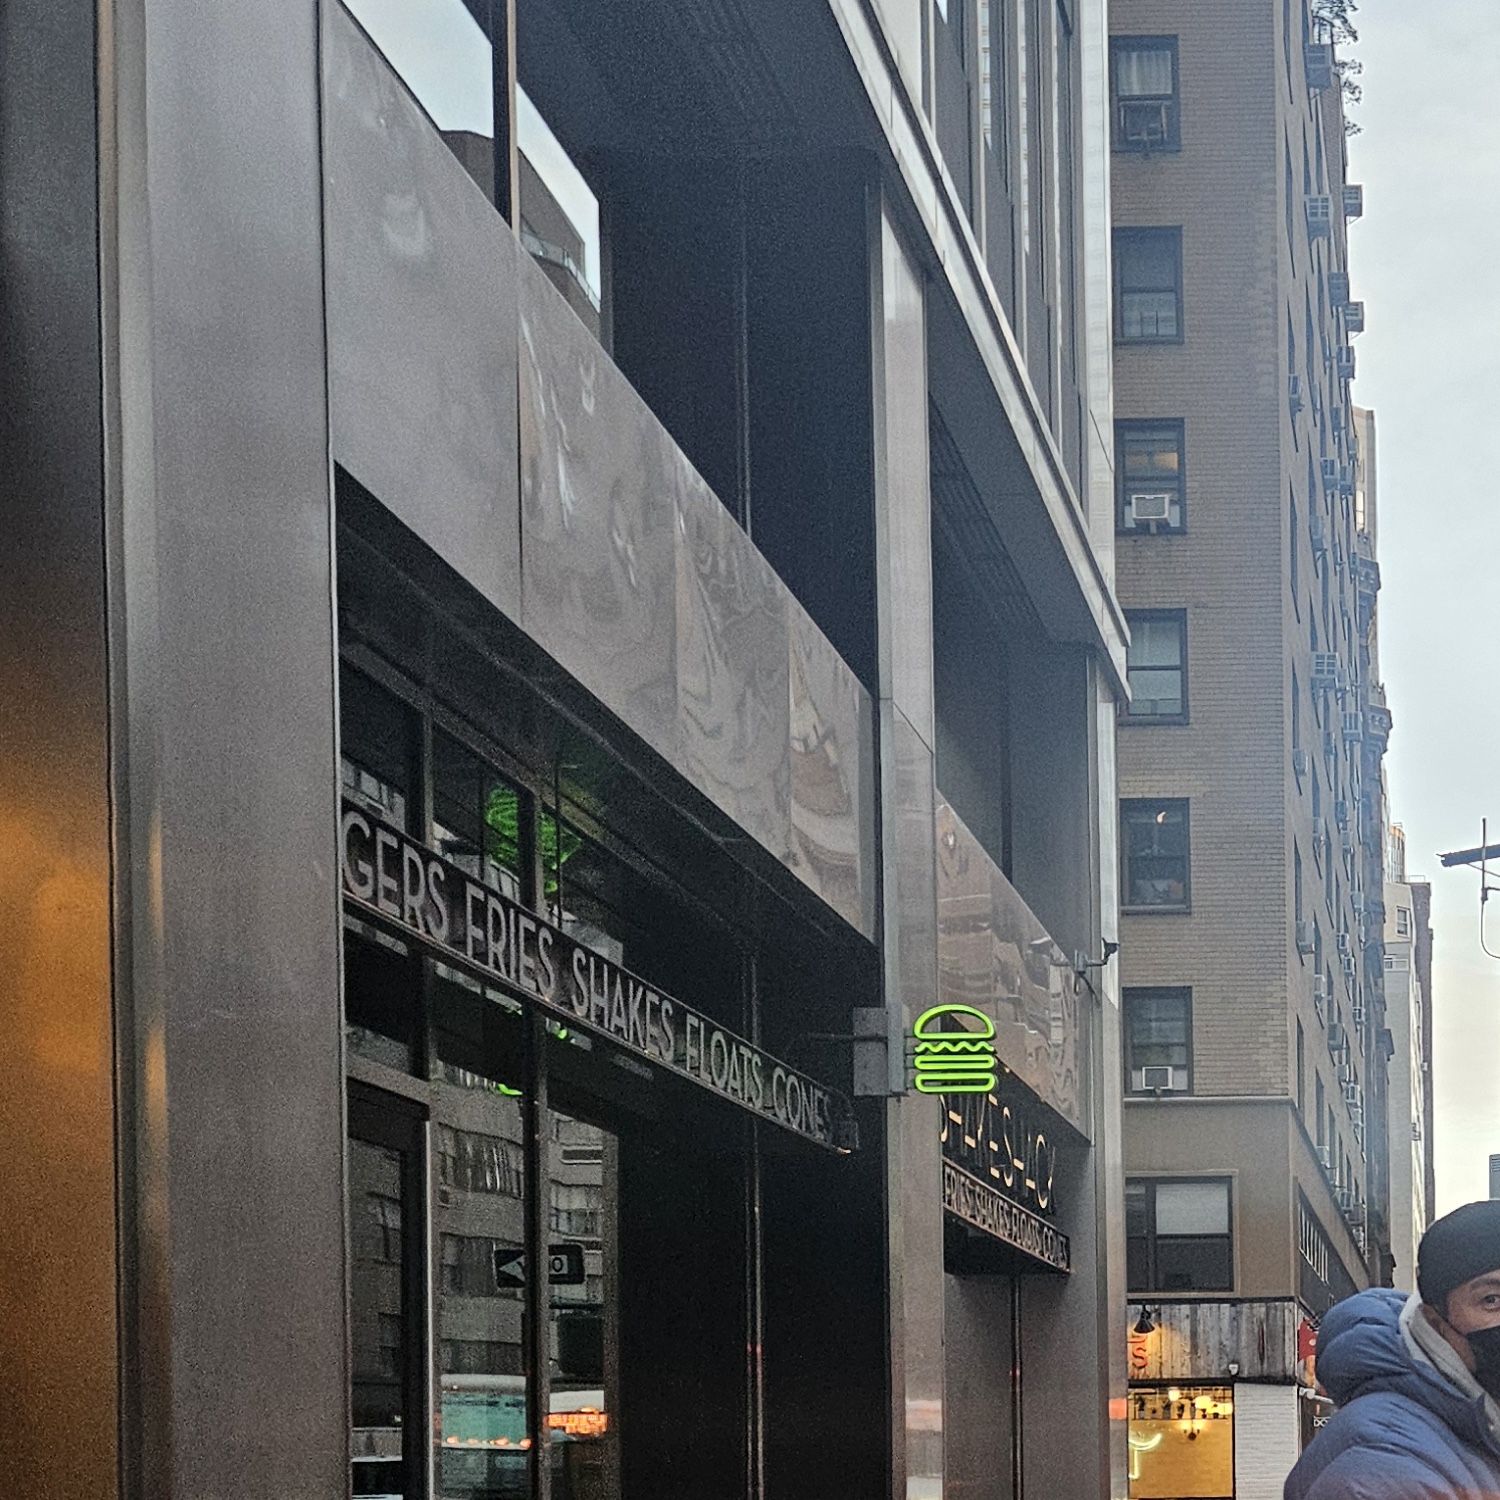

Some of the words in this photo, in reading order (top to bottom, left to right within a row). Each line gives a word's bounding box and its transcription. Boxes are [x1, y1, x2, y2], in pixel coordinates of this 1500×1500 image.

[466, 881, 555, 996] FRIES
[572, 947, 674, 1061] SHAKES
[686, 1013, 763, 1109] FLOATS
[773, 1067, 835, 1142] CONES
[944, 1166, 972, 1218] FRIES
[976, 1186, 1011, 1238] SHAKES
[1013, 1207, 1041, 1256] FLOATS
